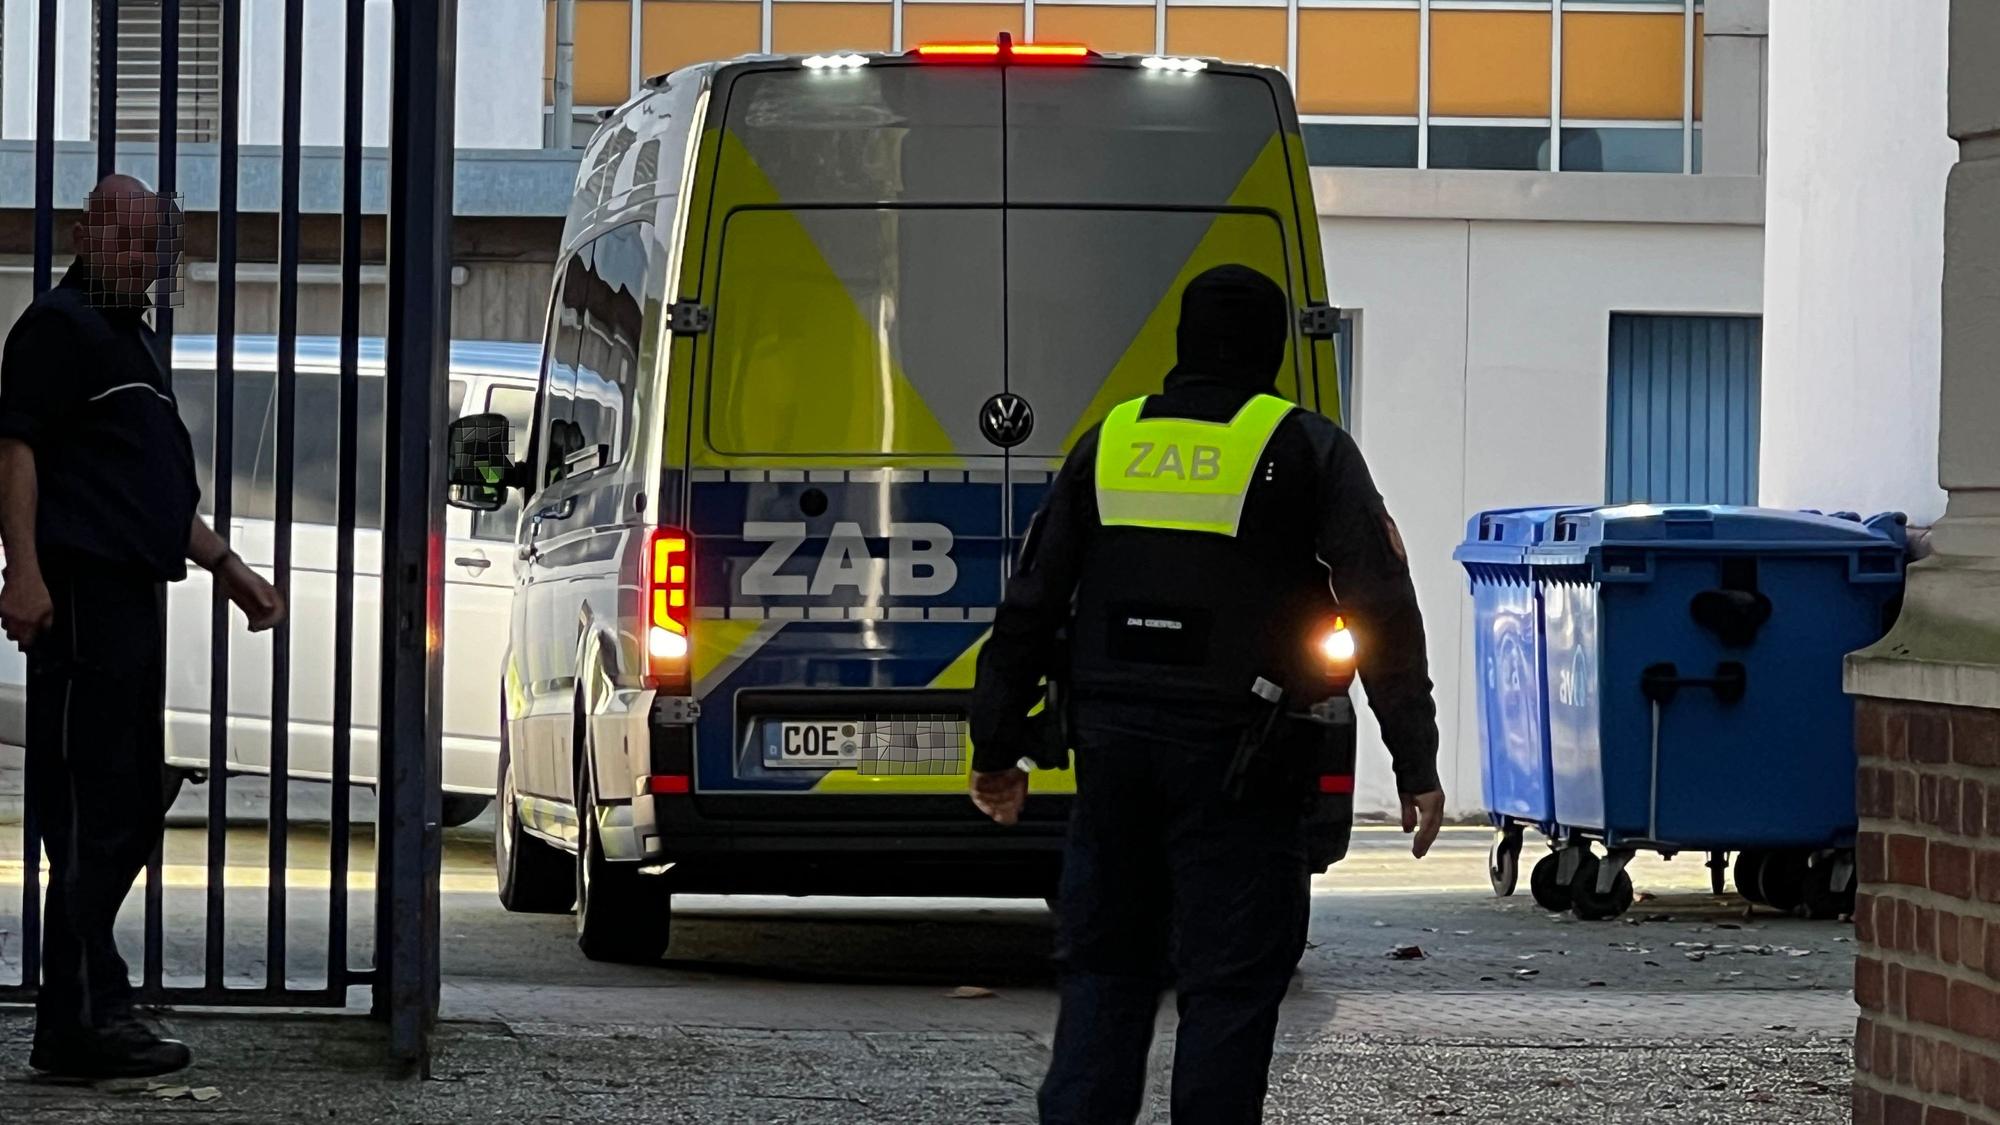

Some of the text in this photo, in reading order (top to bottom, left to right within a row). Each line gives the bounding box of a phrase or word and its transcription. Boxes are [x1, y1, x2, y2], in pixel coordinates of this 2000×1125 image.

[983, 395, 1031, 441] VW
[1124, 441, 1222, 481] ZAB
[740, 521, 959, 596] ZAB
[784, 725, 839, 756] COE
